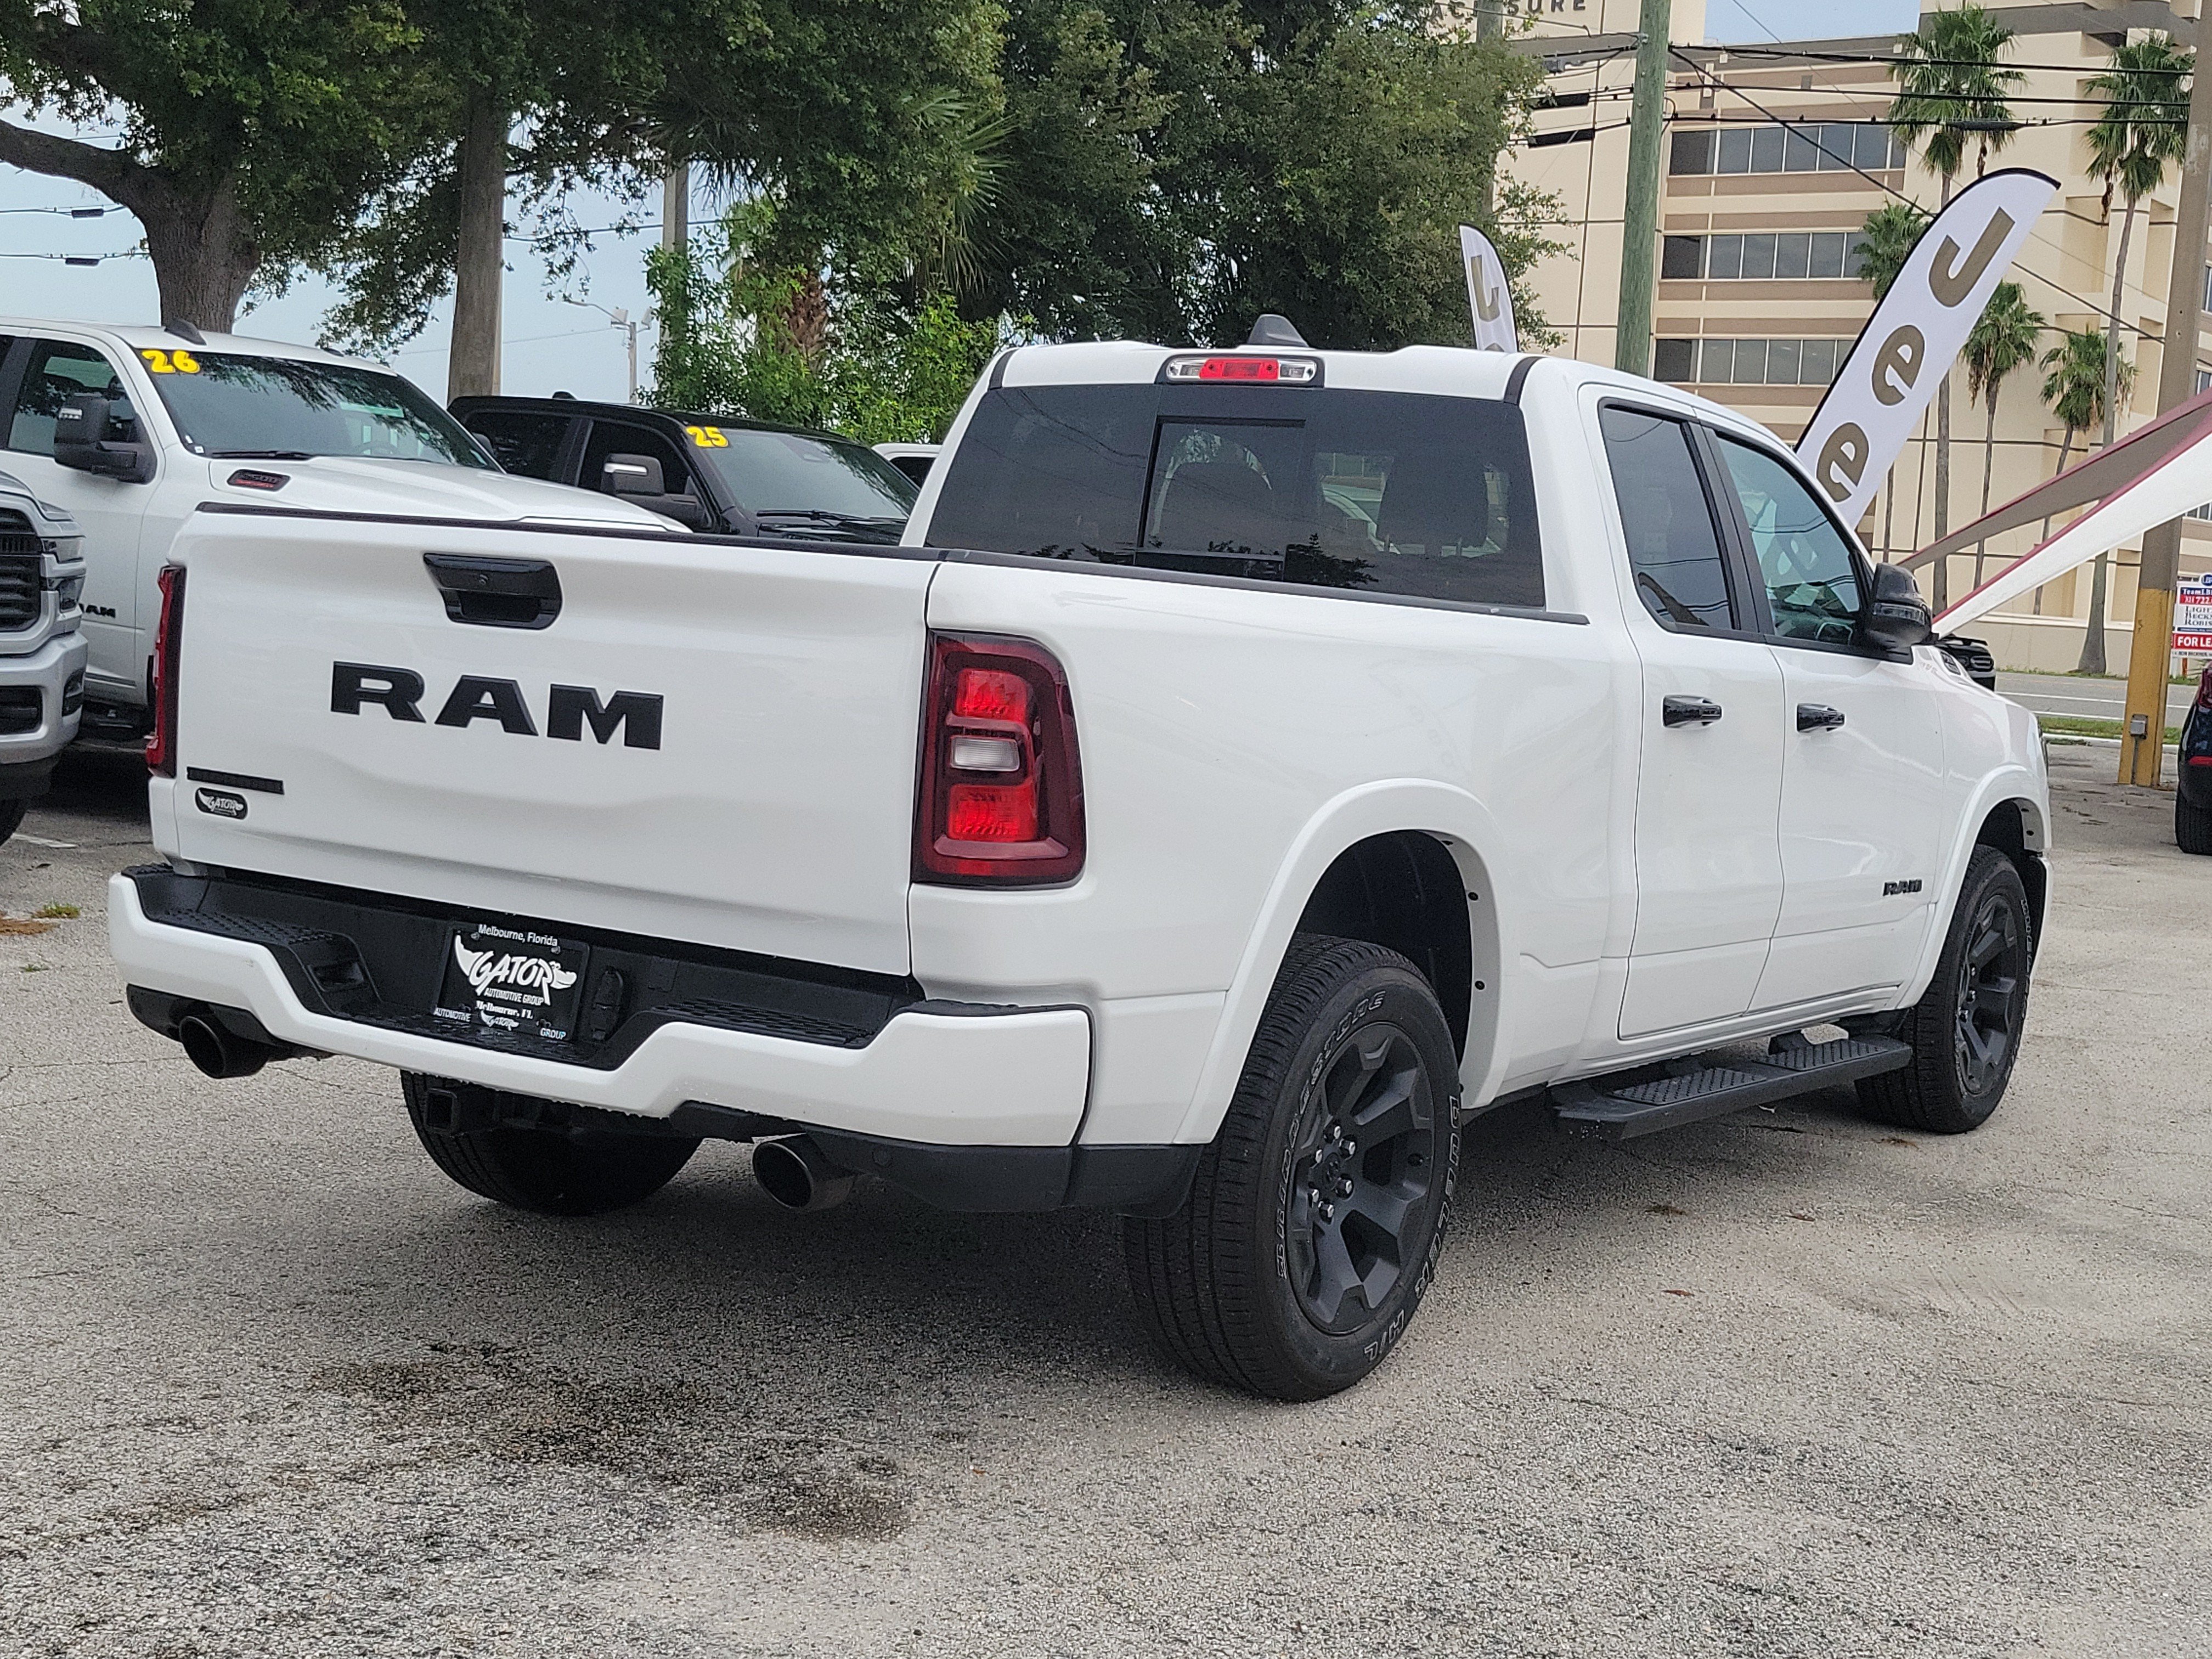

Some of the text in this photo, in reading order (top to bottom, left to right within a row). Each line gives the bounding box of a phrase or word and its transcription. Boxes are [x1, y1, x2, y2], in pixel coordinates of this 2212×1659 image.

[142, 349, 200, 373] 26
[1816, 206, 2016, 503] Jee
[686, 426, 729, 447] 25
[2177, 636, 2212, 647] FOR LE
[330, 661, 664, 751] RAM
[1882, 879, 1922, 896] RAM
[478, 924, 558, 946] Melbourne, Florida
[469, 950, 553, 1006] GATOR
[540, 1028, 566, 1040] GROUP
